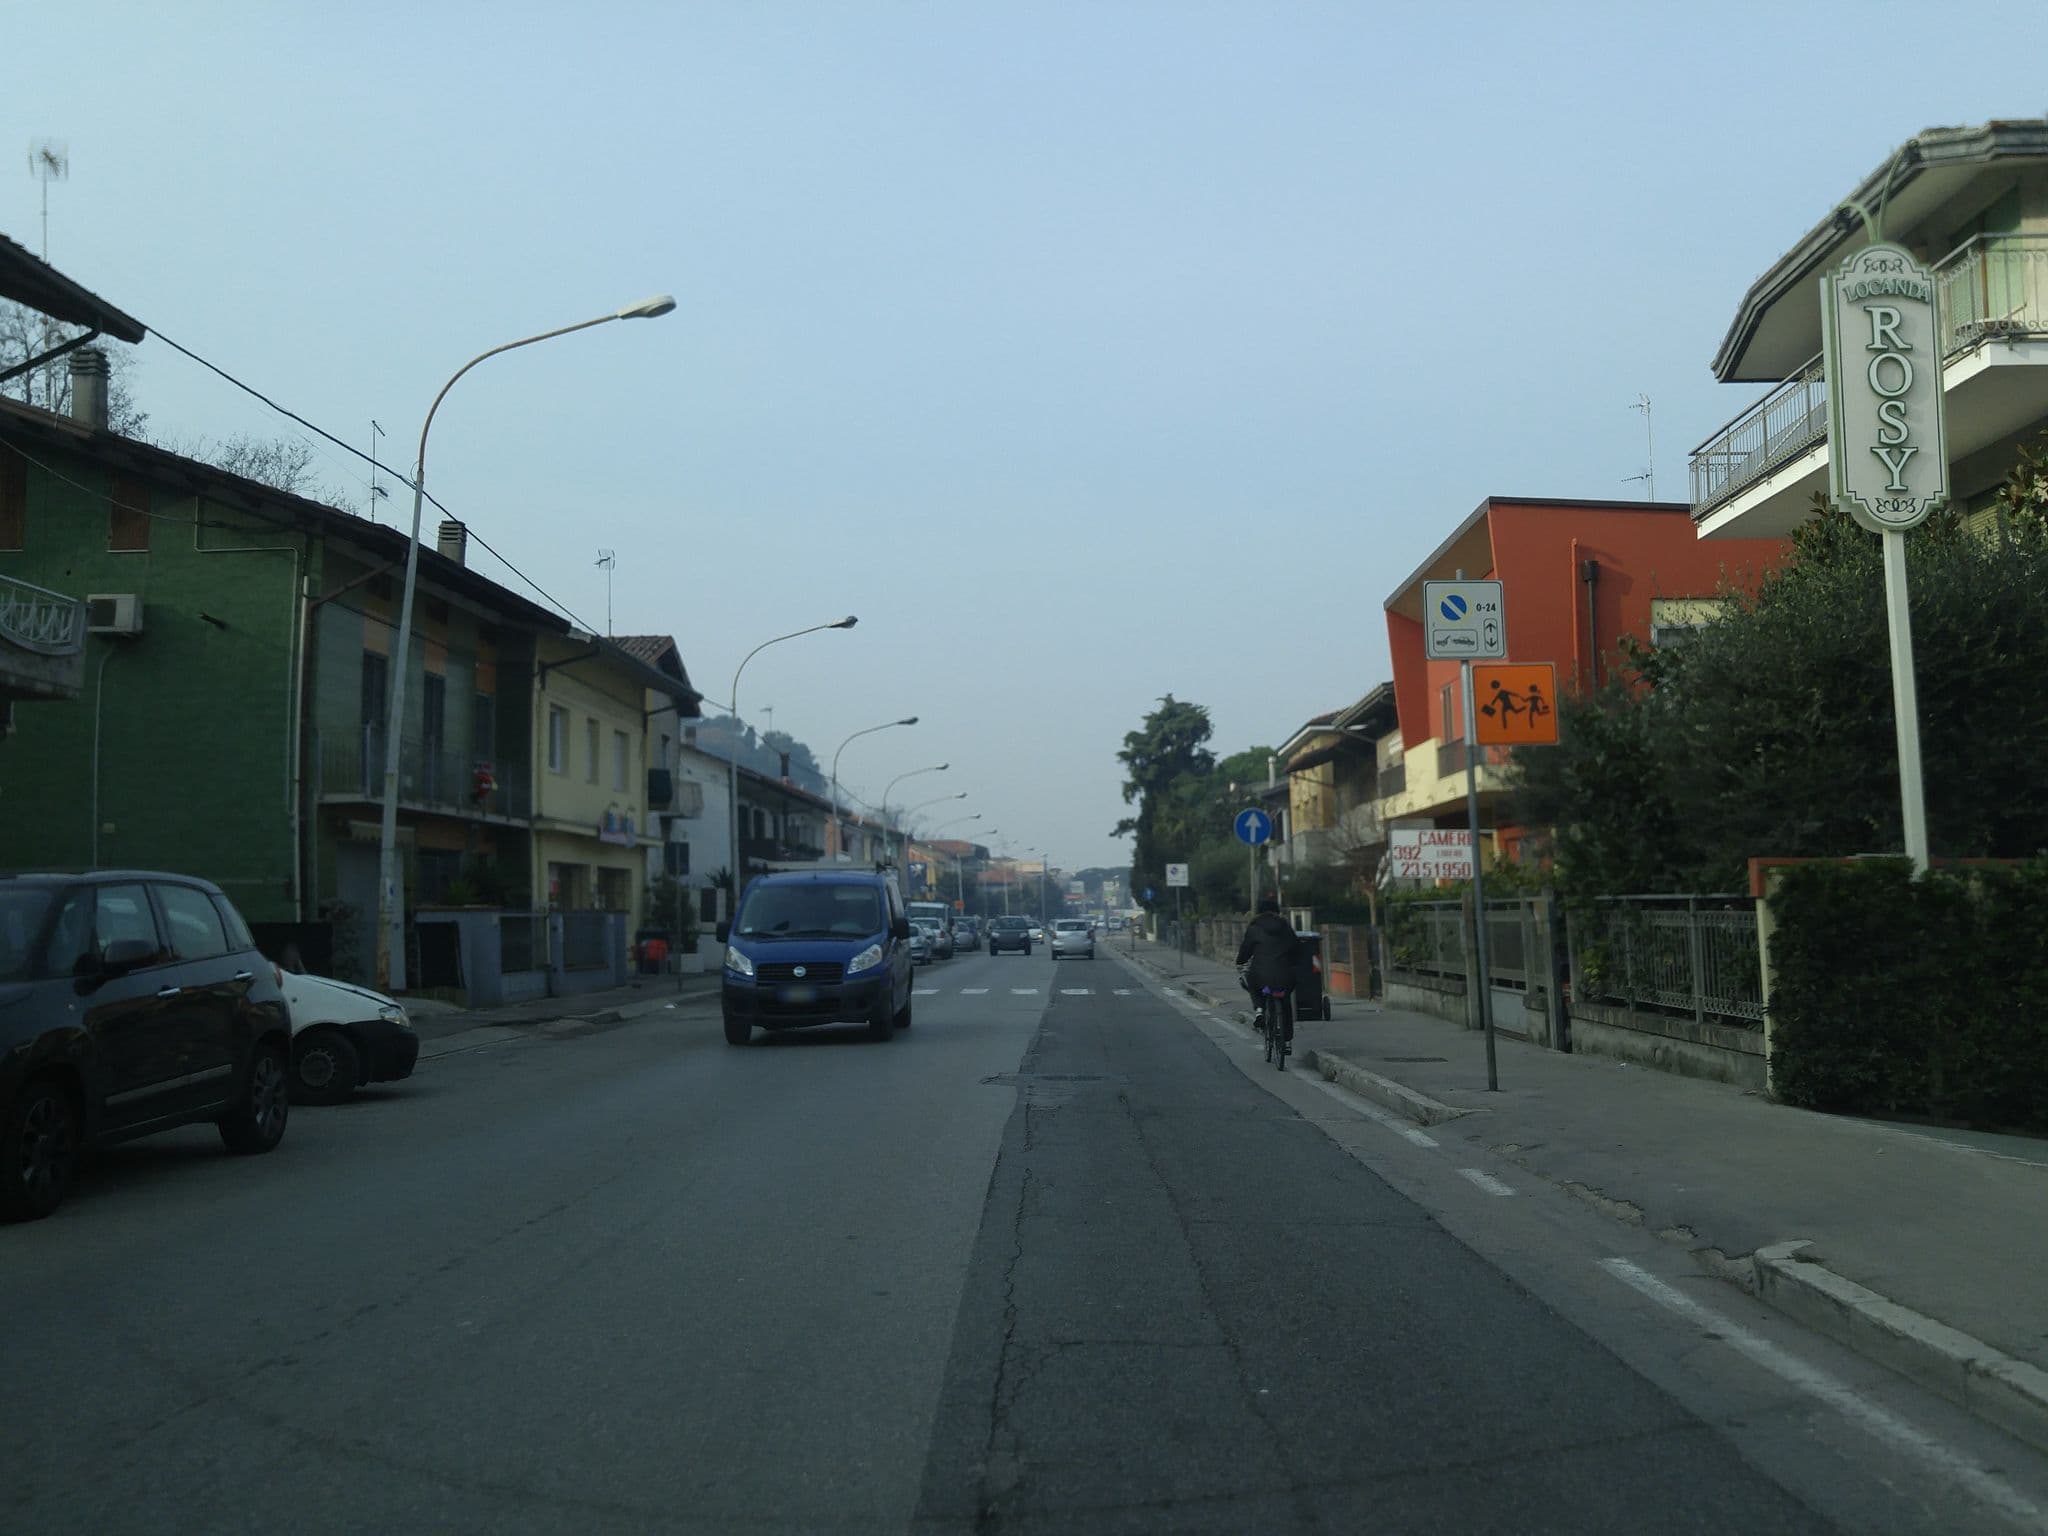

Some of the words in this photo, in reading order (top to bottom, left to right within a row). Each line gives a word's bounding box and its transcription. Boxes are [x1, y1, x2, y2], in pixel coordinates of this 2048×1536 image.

[1842, 279, 1930, 304] LOCANDA
[1863, 306, 1918, 491] ROSY
[1476, 603, 1496, 612] 0-24
